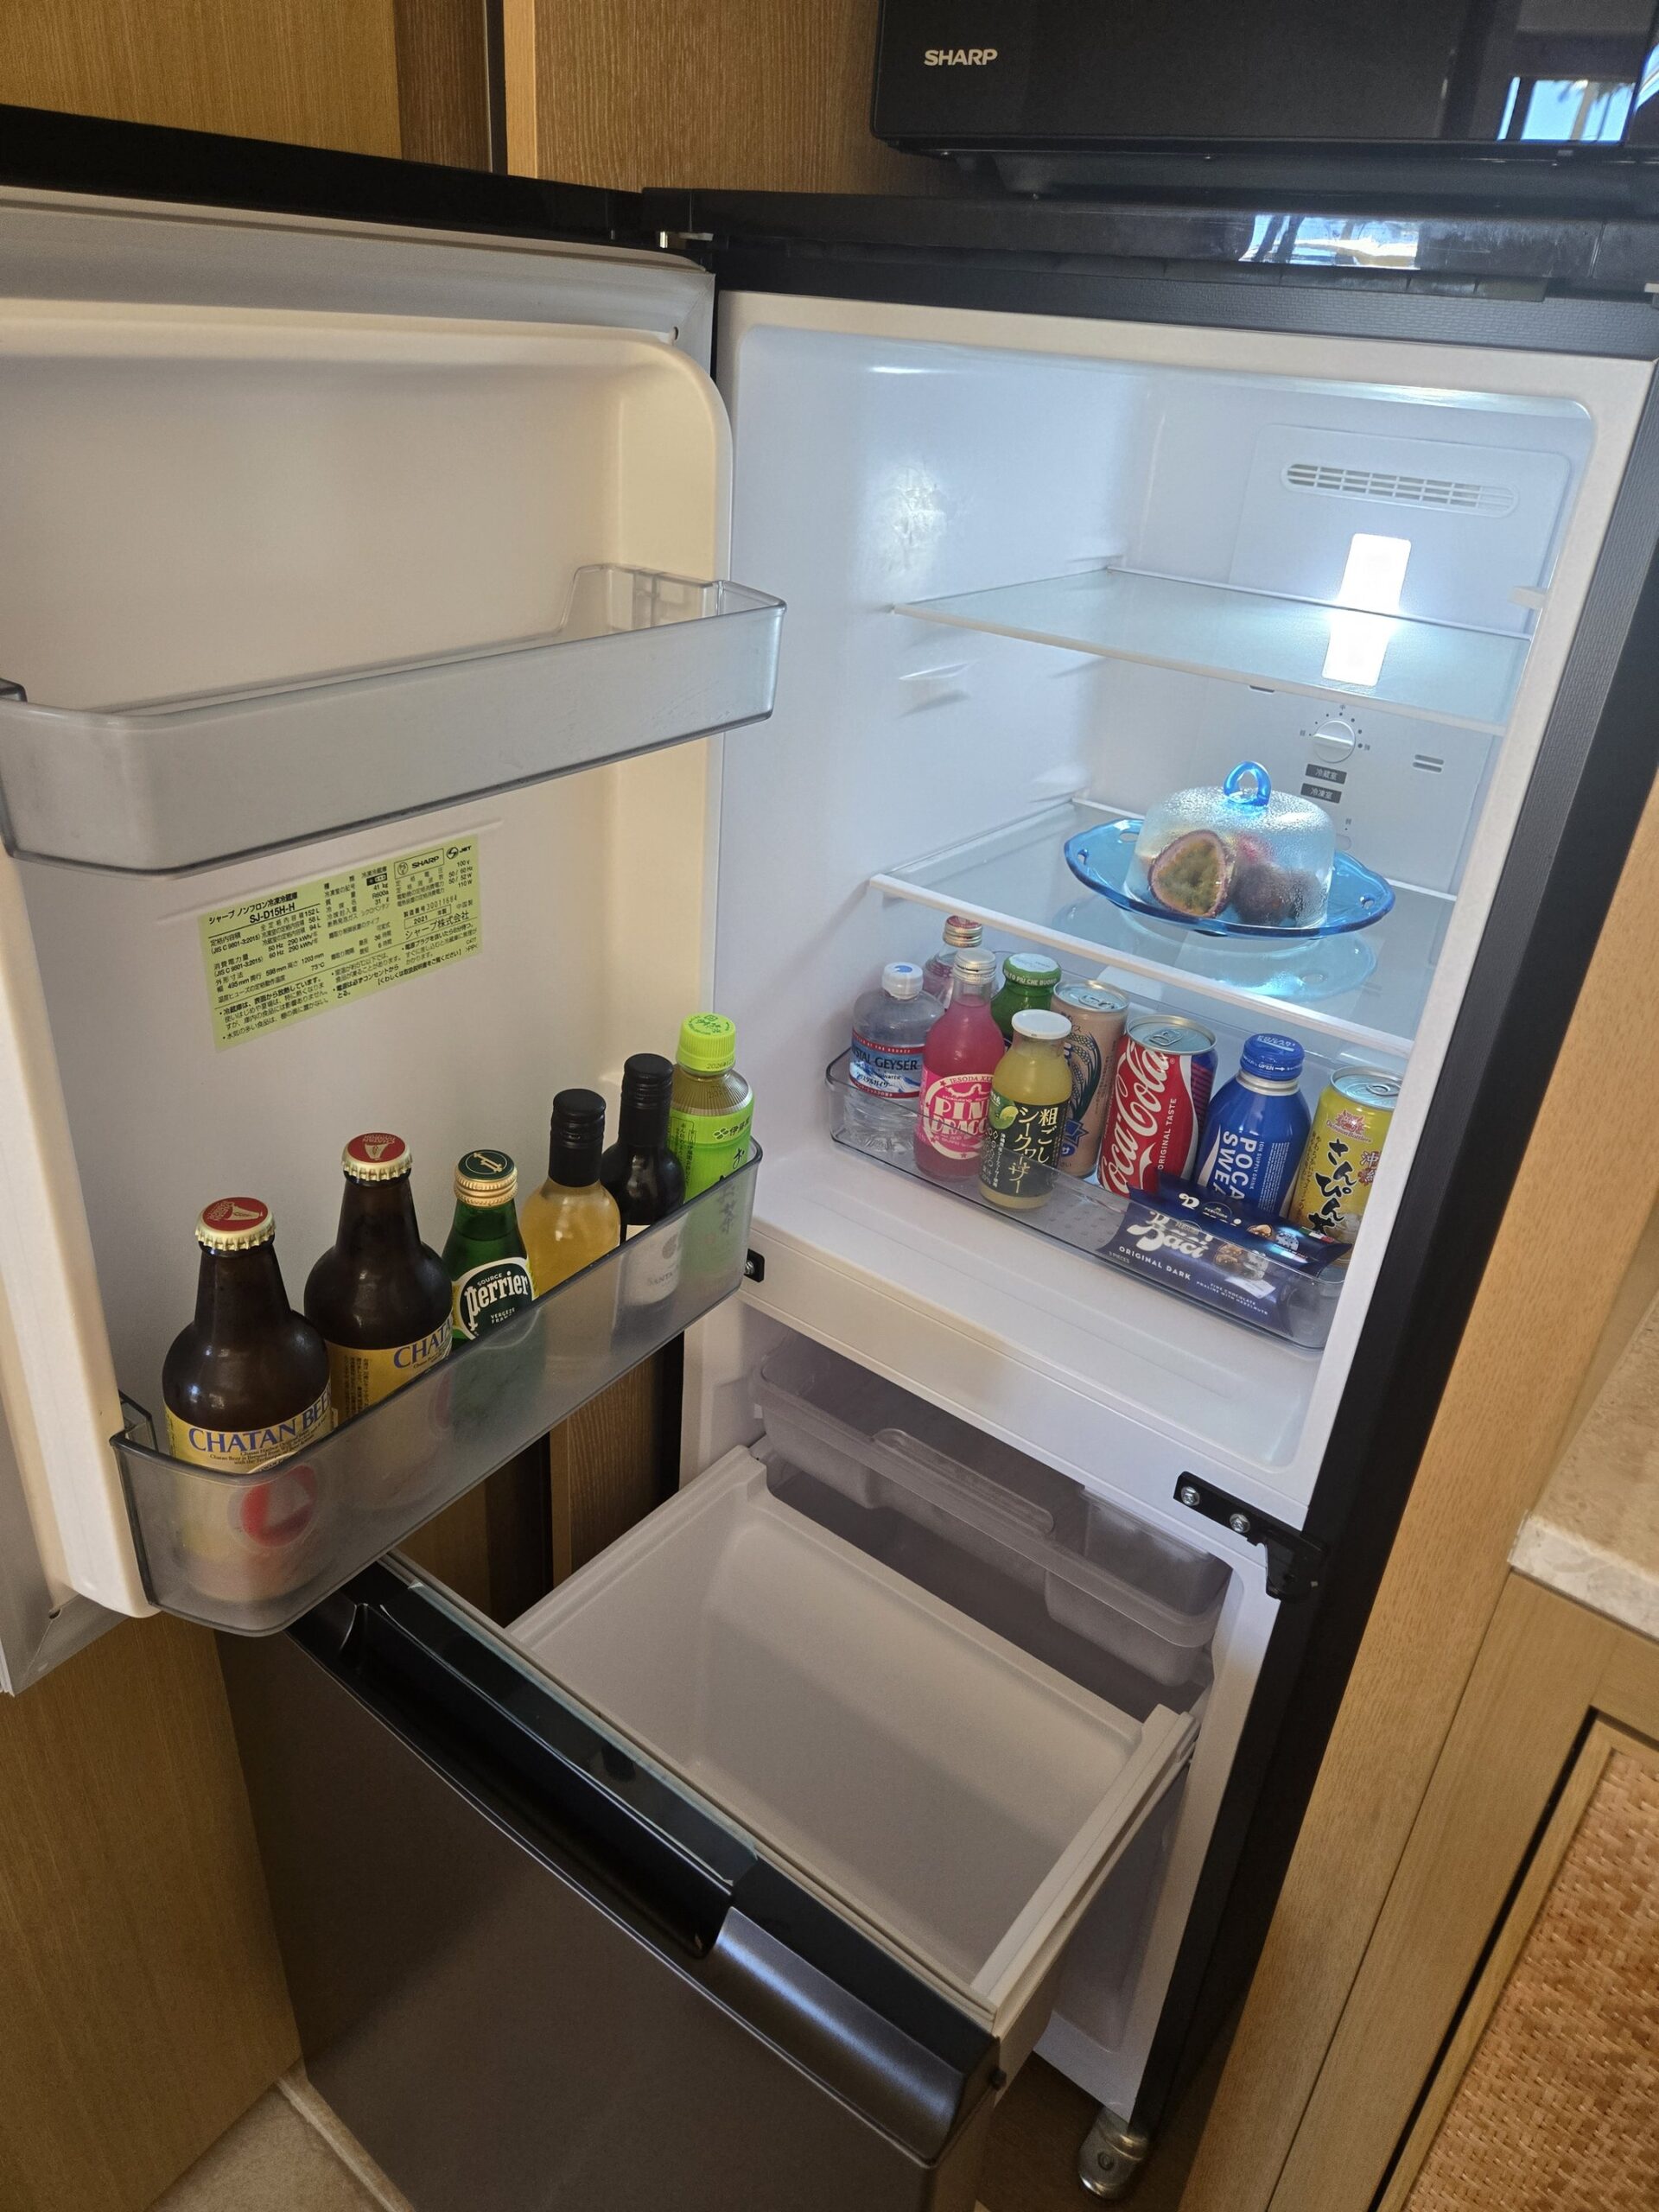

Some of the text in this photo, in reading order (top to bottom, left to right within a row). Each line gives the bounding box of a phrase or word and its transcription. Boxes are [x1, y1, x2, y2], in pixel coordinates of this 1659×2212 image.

[924, 48, 998, 66] SHARP
[411, 855, 440, 869] SHARP
[458, 844, 472, 854] JET
[207, 890, 298, 925] シャープ ノンフロン冷凍冷蔵庫
[248, 901, 296, 925] SJ-D15H-H
[304, 908, 315, 918] 152
[412, 913, 428, 925] 2021
[308, 923, 317, 931] 94
[404, 908, 469, 941] シャープ株式会社
[209, 931, 242, 948] 定格内容積
[210, 945, 222, 956] (JIS
[287, 944, 299, 953] 290
[213, 952, 249, 971] 消費電力量
[275, 942, 283, 950] Hz
[286, 937, 299, 946] 290
[214, 970, 244, 987] 外形寸法
[874, 1057, 918, 1071] GEYSER
[935, 1096, 989, 1120] PIN
[1102, 1039, 1170, 1194] Coca-Cola
[1038, 1107, 1058, 1163] 粗ごし
[1157, 1098, 1177, 1170] ORIGINAL TASTE
[1229, 1137, 1257, 1199] POCA
[1118, 1246, 1192, 1281] ORIGINAL DARK
[477, 1272, 503, 1286] SOURCE
[464, 1270, 529, 1332] Perrier
[188, 1419, 297, 1453] CHATAN
